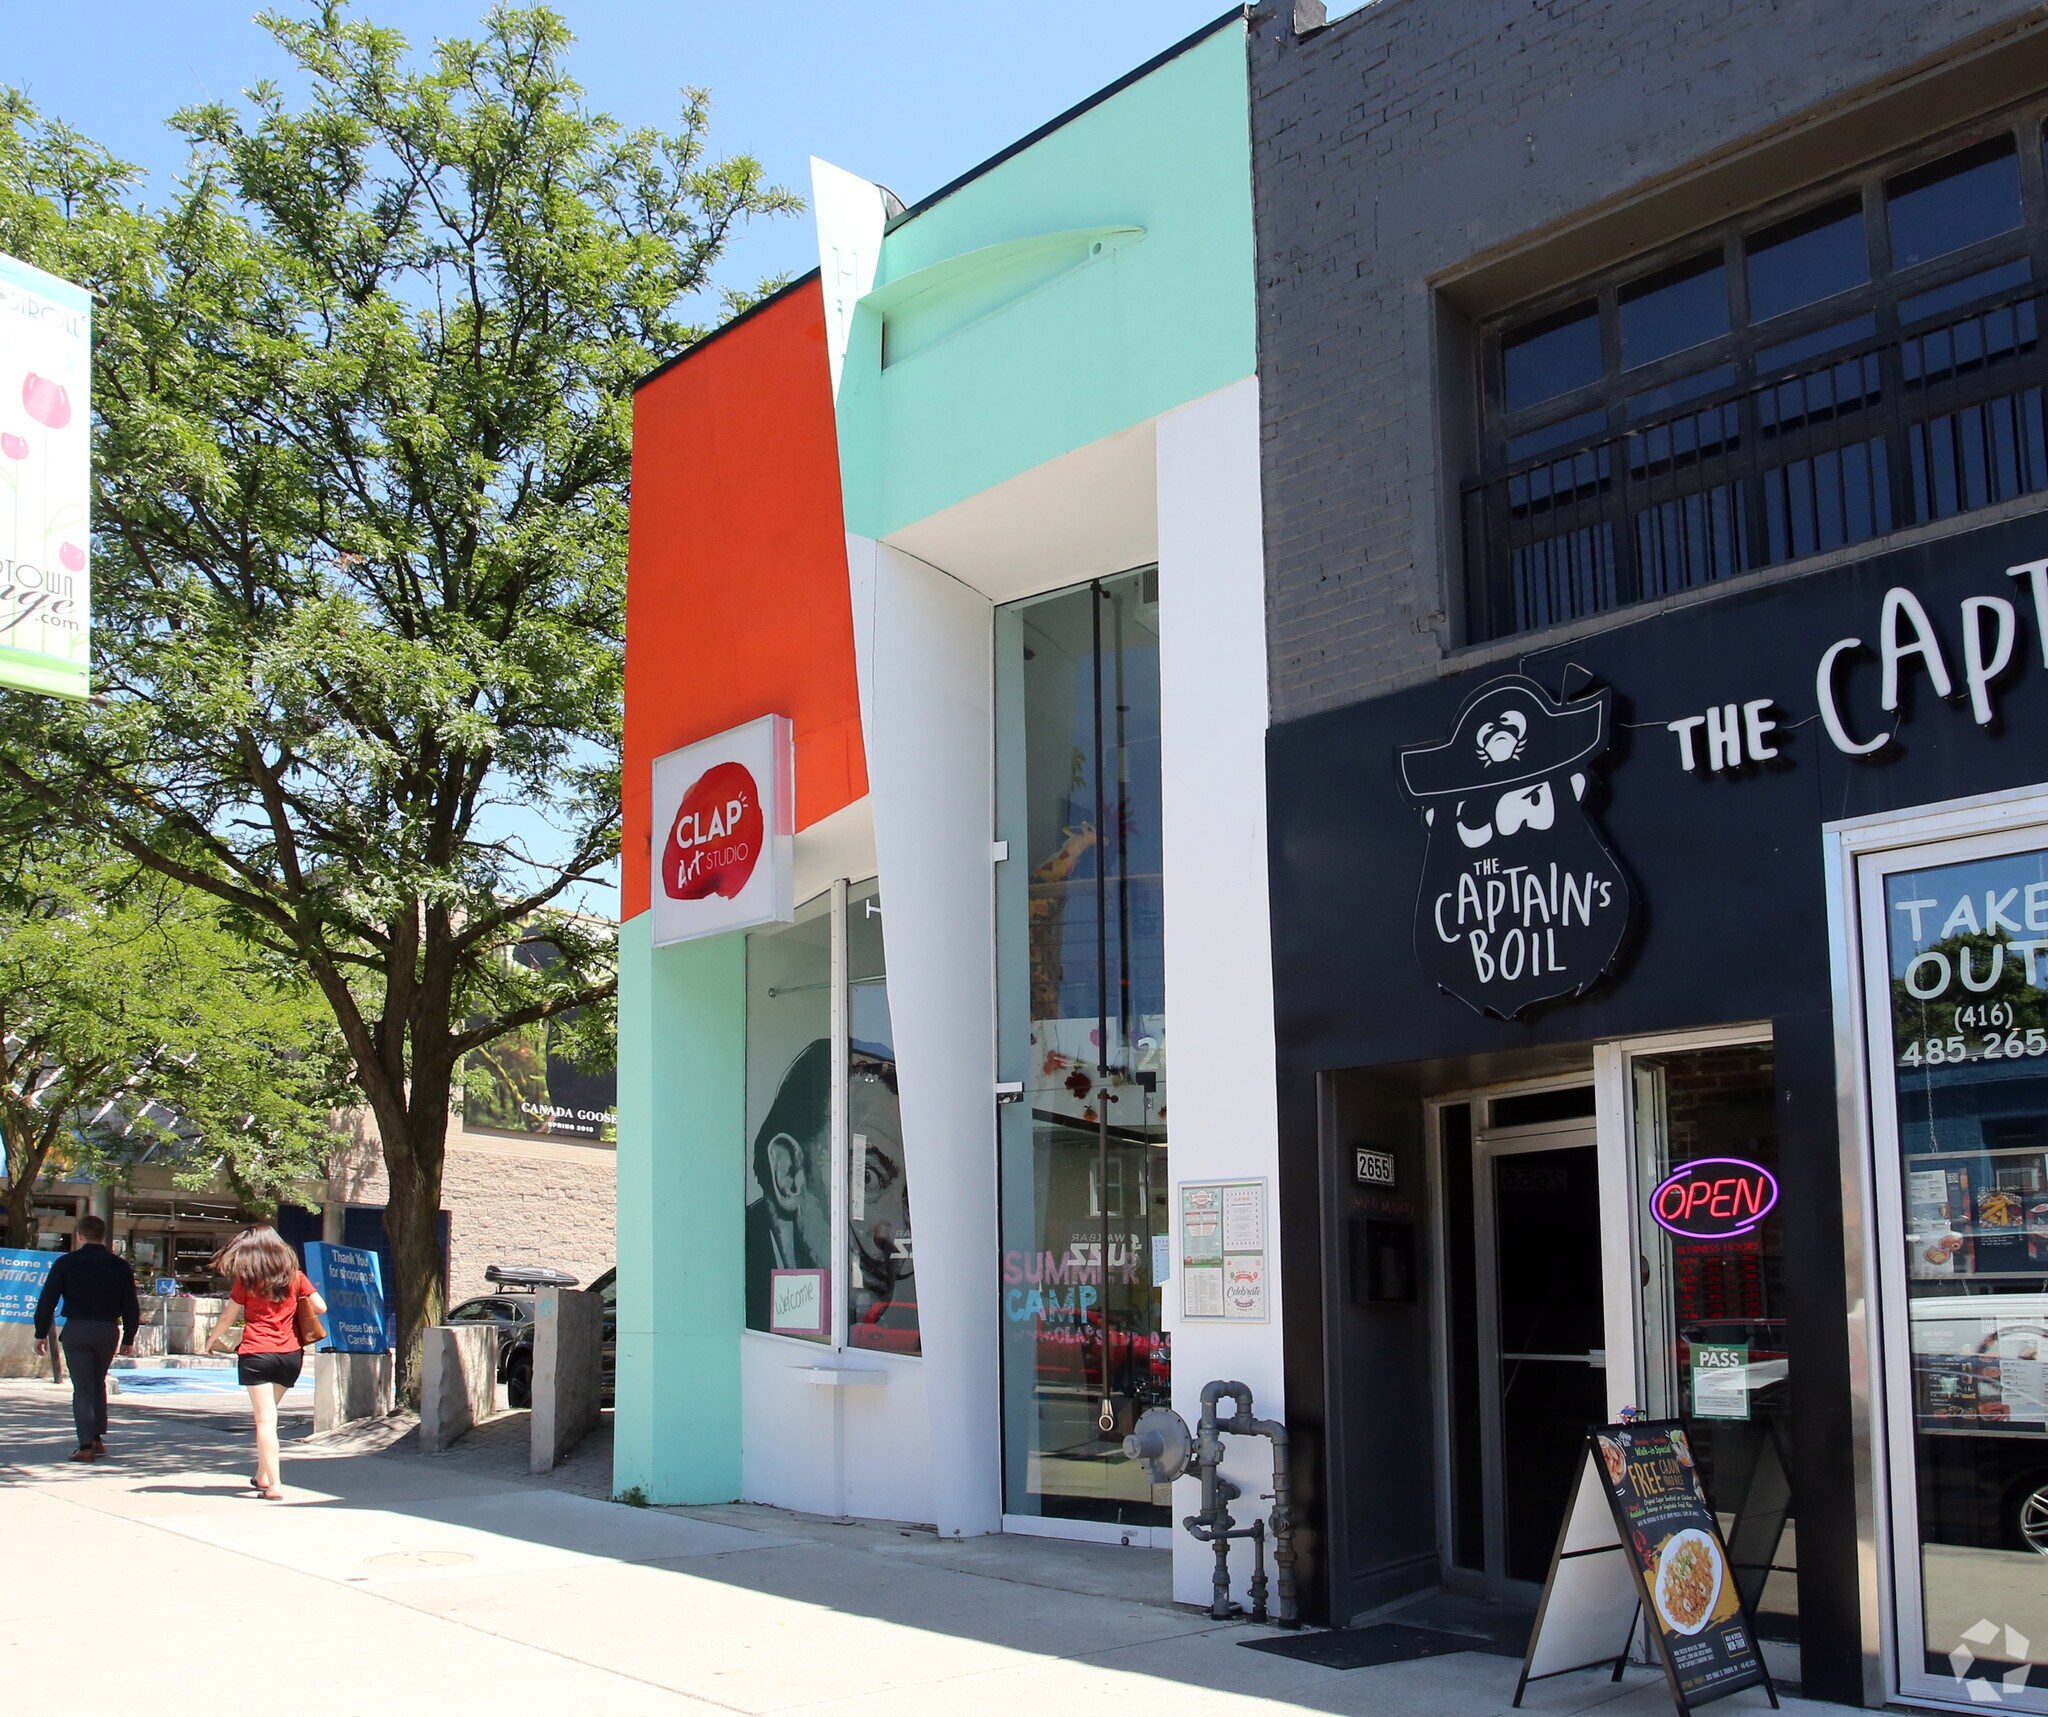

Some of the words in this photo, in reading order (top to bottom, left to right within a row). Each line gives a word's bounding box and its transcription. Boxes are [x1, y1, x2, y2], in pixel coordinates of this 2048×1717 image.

[1666, 698, 1778, 771] THE
[677, 799, 742, 849] CLAP
[706, 842, 749, 870] STUDIO
[1473, 858, 1499, 876] THE
[1895, 881, 2048, 942] TAKE
[1469, 928, 1567, 984] BOIL
[1904, 939, 2048, 1000] OUT
[1954, 1001, 2013, 1034] (416)
[521, 1102, 574, 1119] CANADA
[577, 1109, 618, 1125] GOOSE
[547, 1121, 575, 1130] SPRING
[1360, 1155, 1390, 1180] 2655
[1657, 1176, 1764, 1220] OPEN
[332, 1249, 356, 1266] Thank
[1723, 1241, 1760, 1252] HOURS
[0, 1256, 41, 1268] lcome
[329, 1265, 339, 1278] for
[339, 1266, 368, 1285] shopping
[775, 1283, 814, 1316] Welcome
[1005, 1285, 1098, 1325] CAMP
[1226, 1285, 1261, 1299] Celebrate
[339, 1321, 362, 1333] Please
[1699, 1351, 1740, 1367] PASS
[1627, 1461, 1665, 1498] FREE
[1658, 1458, 1681, 1476] CAJUN
